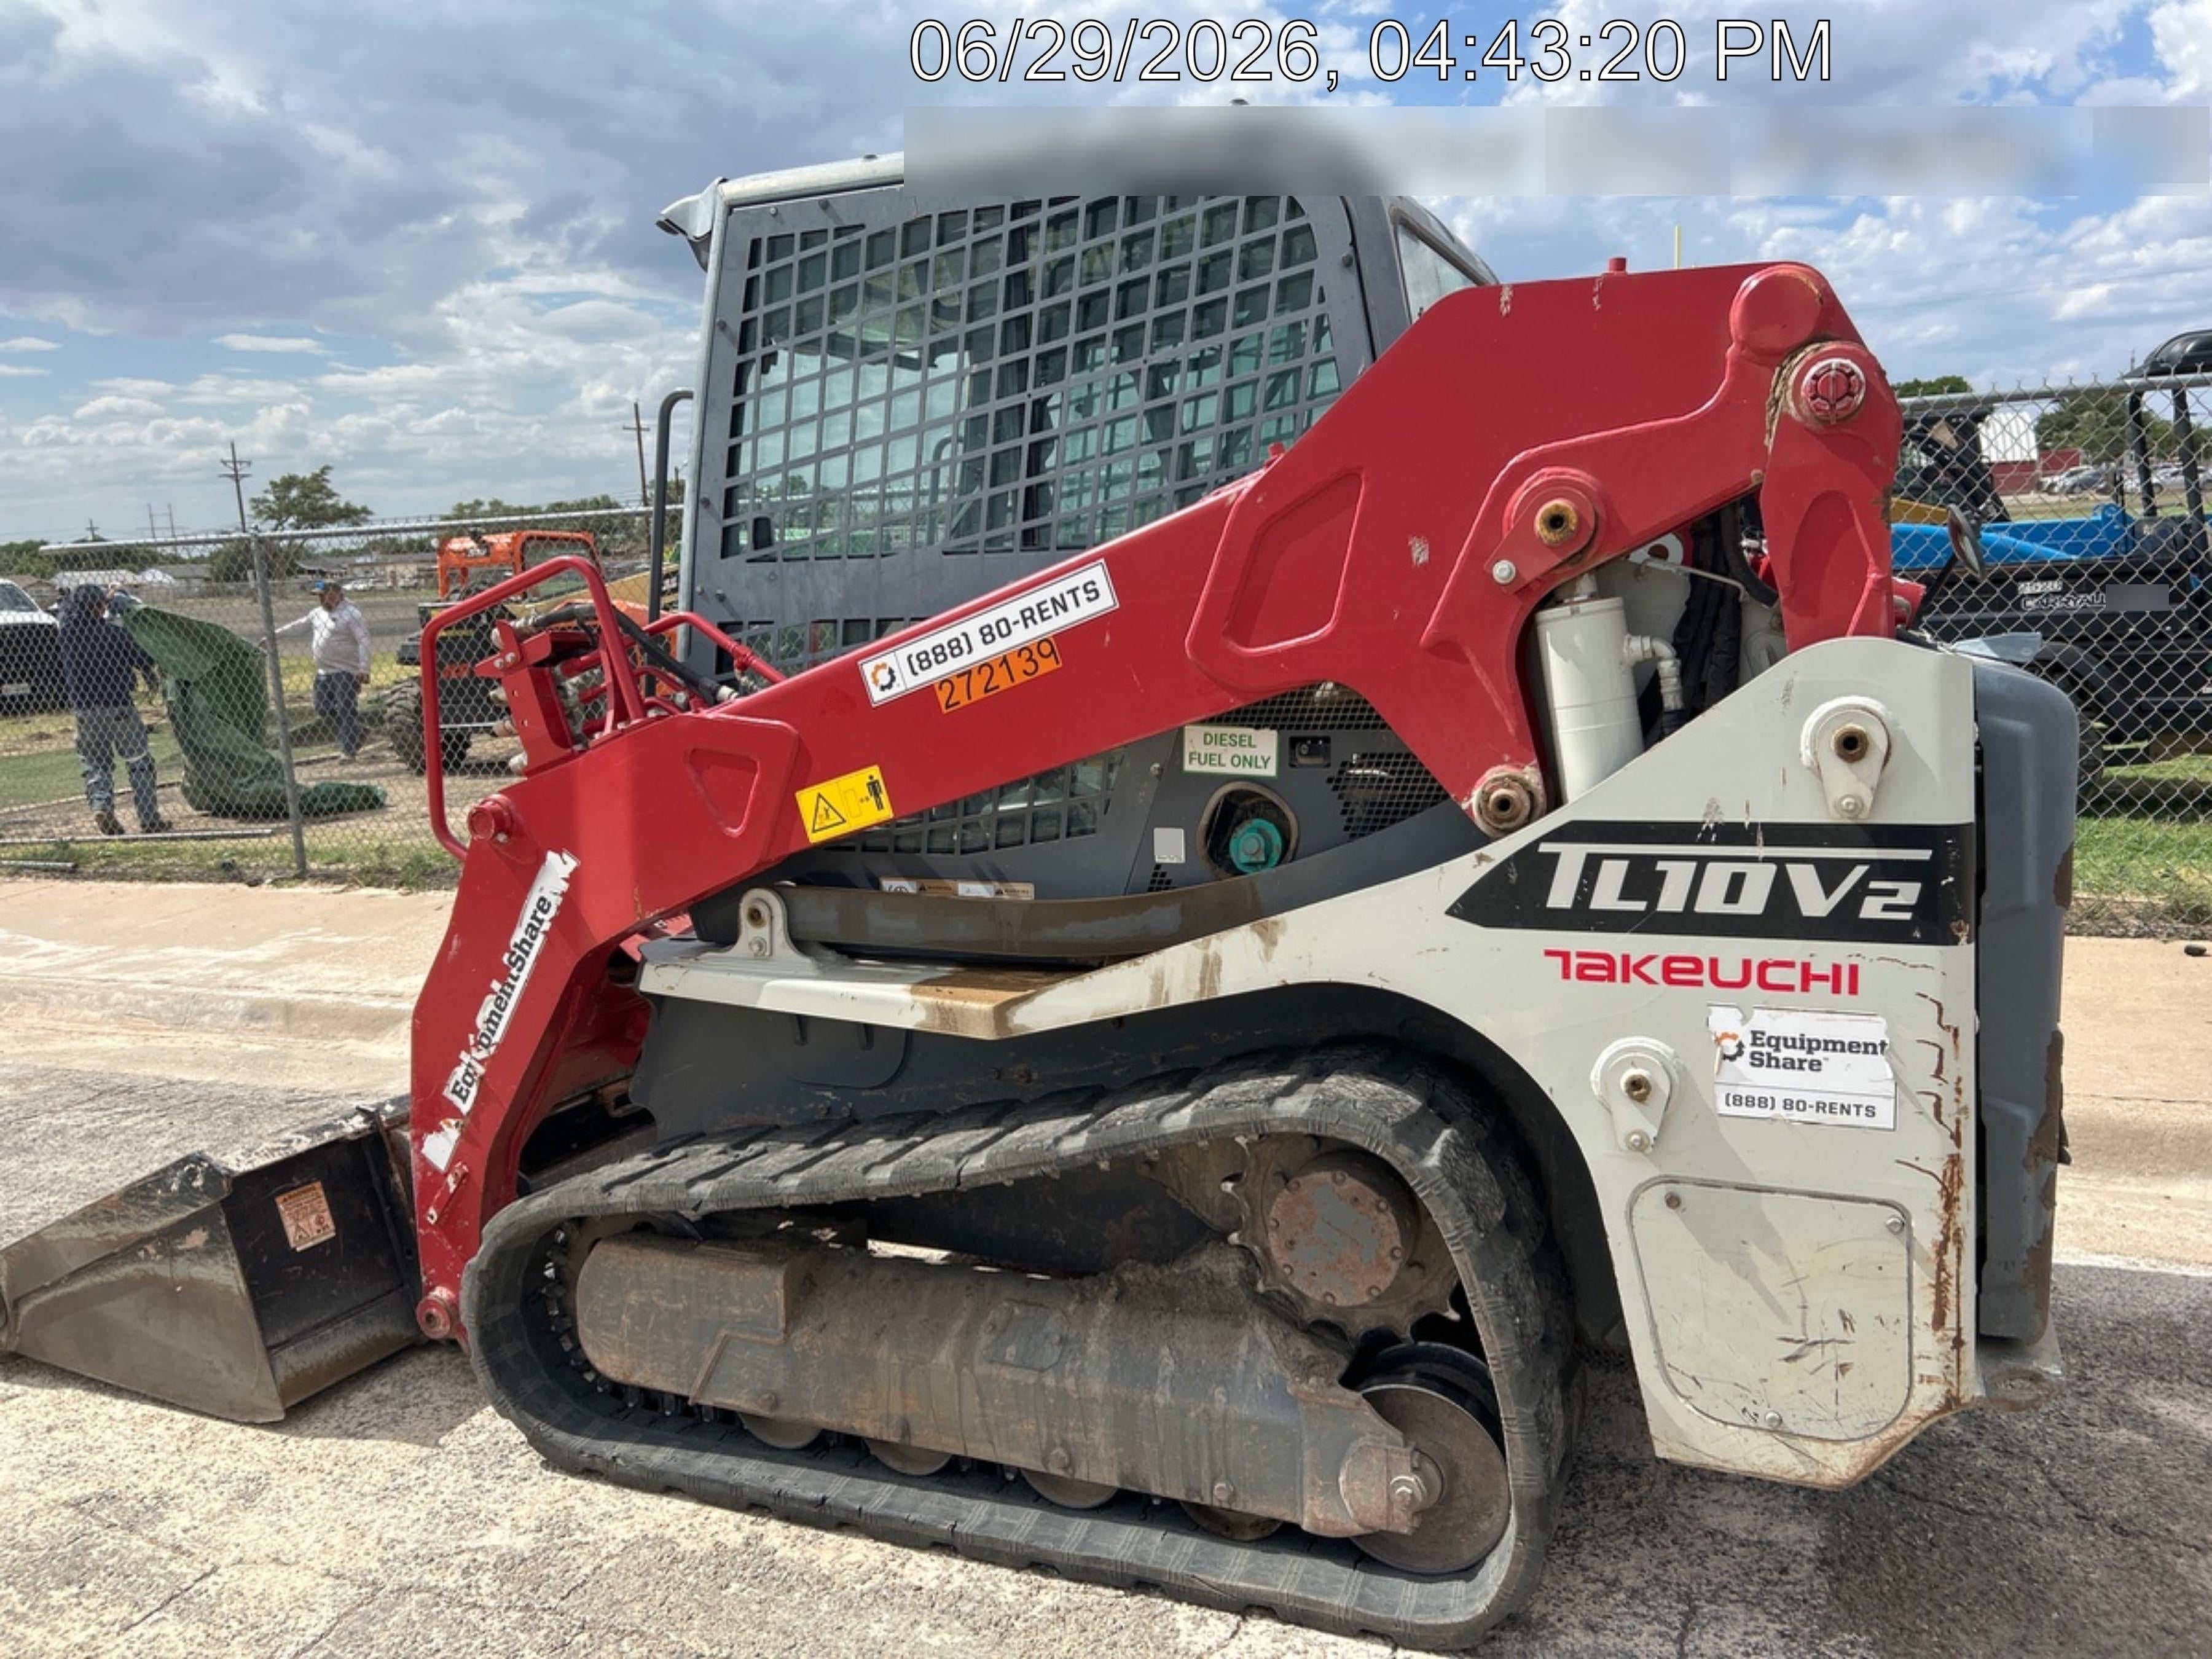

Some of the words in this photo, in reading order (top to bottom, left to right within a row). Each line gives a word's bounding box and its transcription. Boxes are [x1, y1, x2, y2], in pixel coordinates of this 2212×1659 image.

[906, 632, 973, 676] (888)
[979, 579, 1100, 646] 80-RENTS
[938, 637, 1061, 710] 272139
[1202, 732, 1257, 748] DIESEL
[1188, 752, 1226, 767] FUEL
[1230, 753, 1271, 769] ONLY
[1537, 842, 1932, 920] TL10V2
[1749, 1030, 1888, 1056] Equipment
[1749, 1051, 1822, 1072] Share
[1725, 1092, 1776, 1110] (888)
[1783, 1098, 1877, 1118] 80-RENTS
